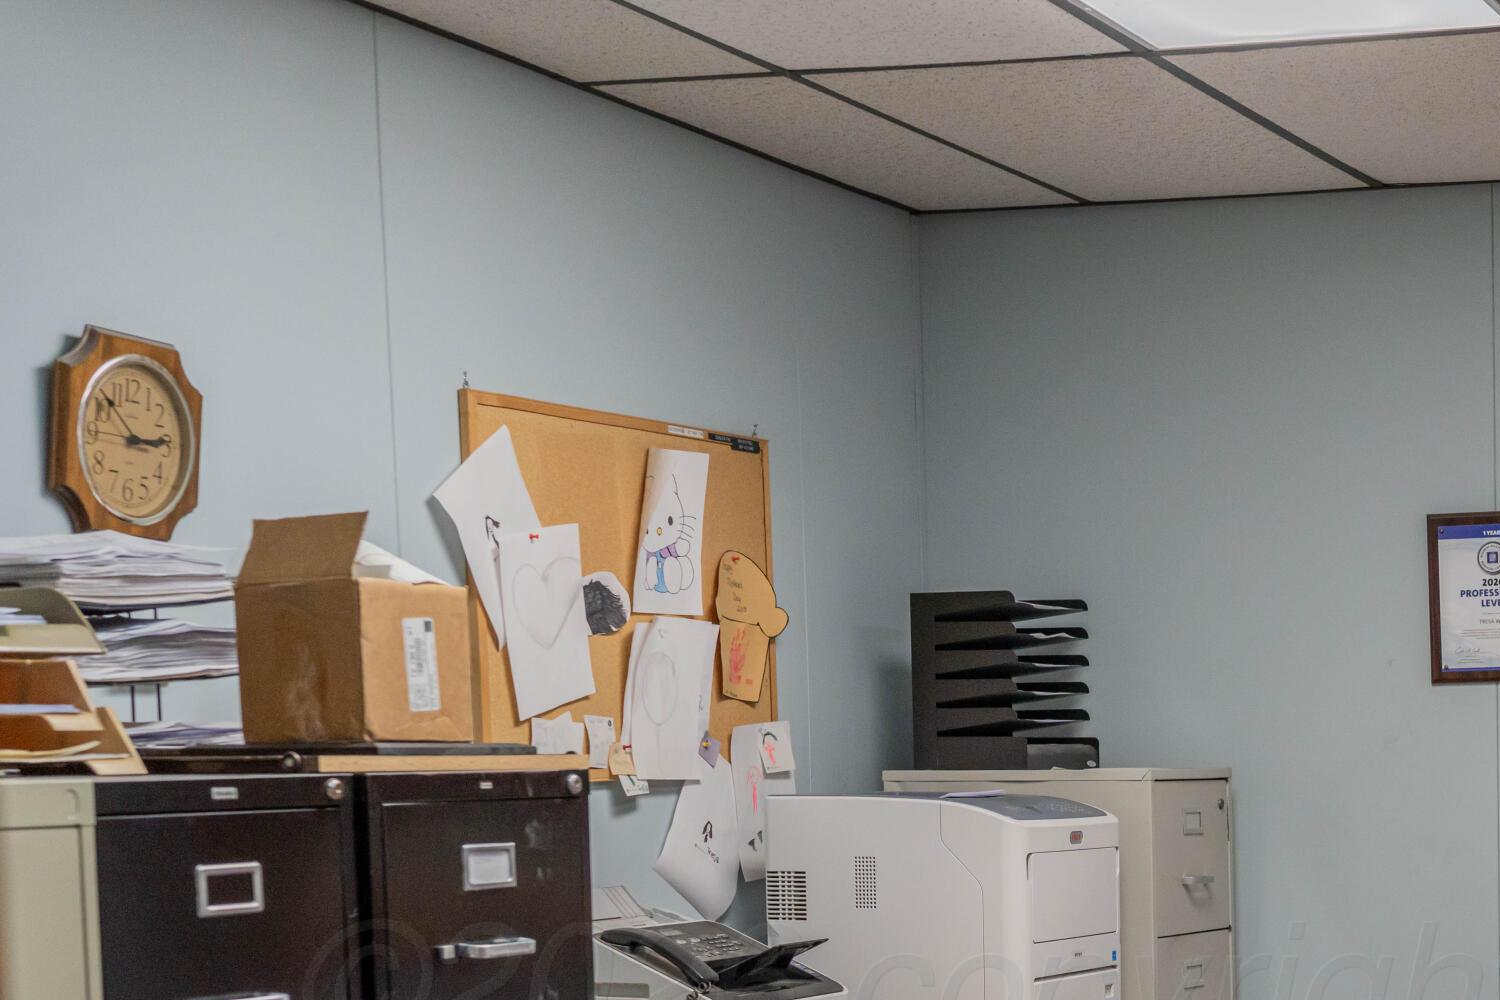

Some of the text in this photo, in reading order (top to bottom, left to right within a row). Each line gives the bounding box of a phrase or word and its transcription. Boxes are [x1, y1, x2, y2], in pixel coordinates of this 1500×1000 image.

[112, 382, 123, 407] 11
[125, 378, 140, 404] 12
[145, 387, 152, 412] 1
[153, 403, 165, 428] 2
[86, 420, 99, 444] 9
[159, 433, 172, 458] 3
[92, 449, 105, 475] 8
[151, 461, 163, 485] 4
[107, 468, 120, 493] 7
[121, 477, 134, 502] 6
[137, 475, 150, 500] 5
